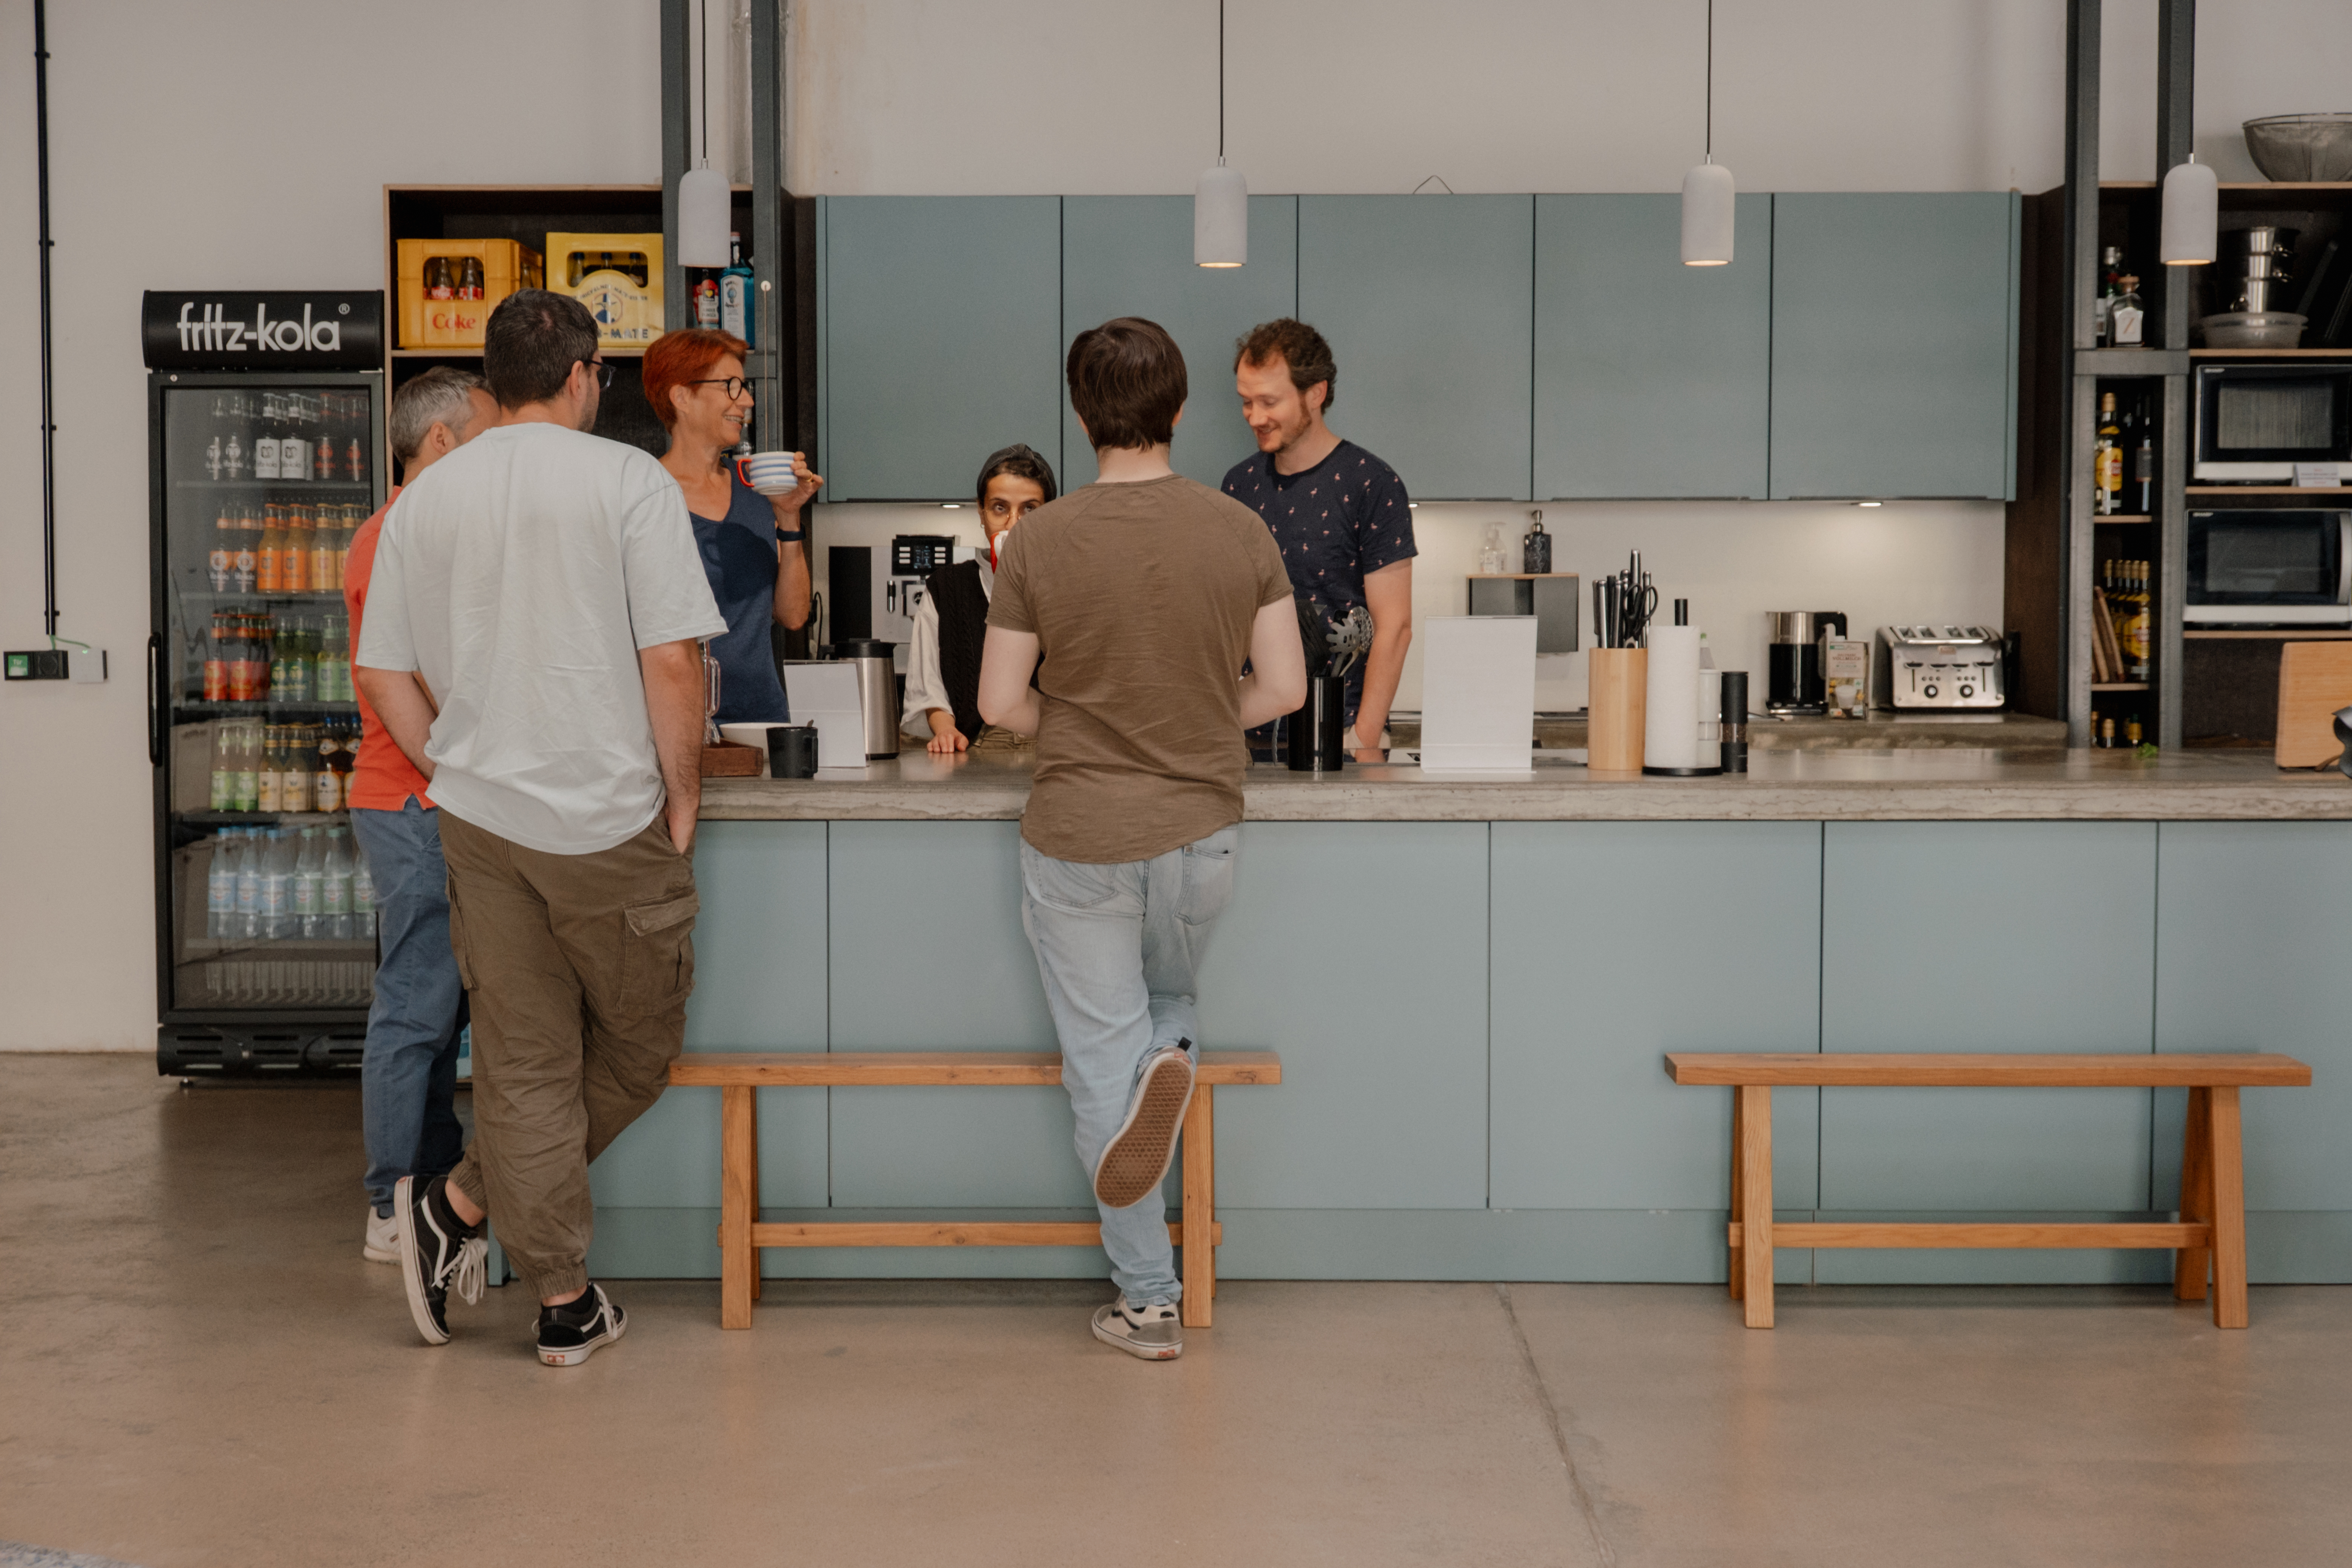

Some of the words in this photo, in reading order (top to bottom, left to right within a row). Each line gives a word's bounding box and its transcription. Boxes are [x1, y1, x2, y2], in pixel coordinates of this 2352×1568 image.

[177, 302, 340, 351] fritz-kola
[432, 313, 475, 329] Coke
[597, 328, 648, 338] B-MATE
